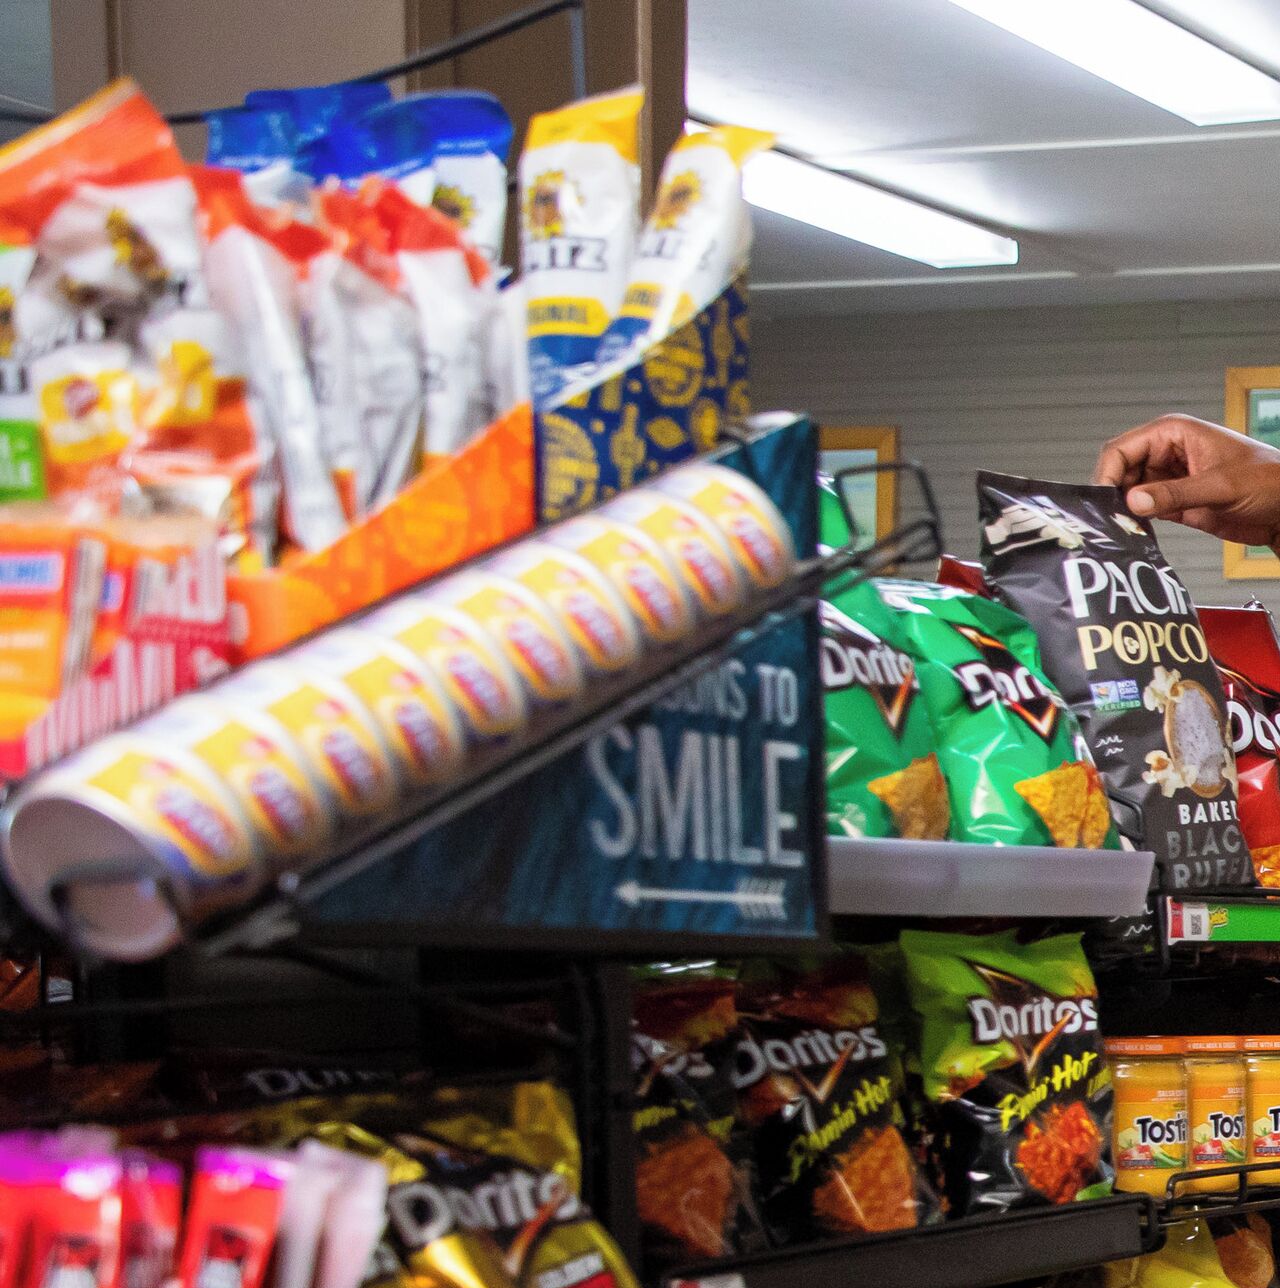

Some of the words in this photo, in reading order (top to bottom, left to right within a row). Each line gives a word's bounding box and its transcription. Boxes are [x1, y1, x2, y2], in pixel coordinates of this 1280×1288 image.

[821, 638, 920, 689] Dorito
[757, 663, 799, 727] TO
[584, 722, 806, 868] SMILE
[974, 1000, 1098, 1043] Doritos
[731, 1026, 885, 1090] Doritos
[1051, 1051, 1098, 1092] Hot
